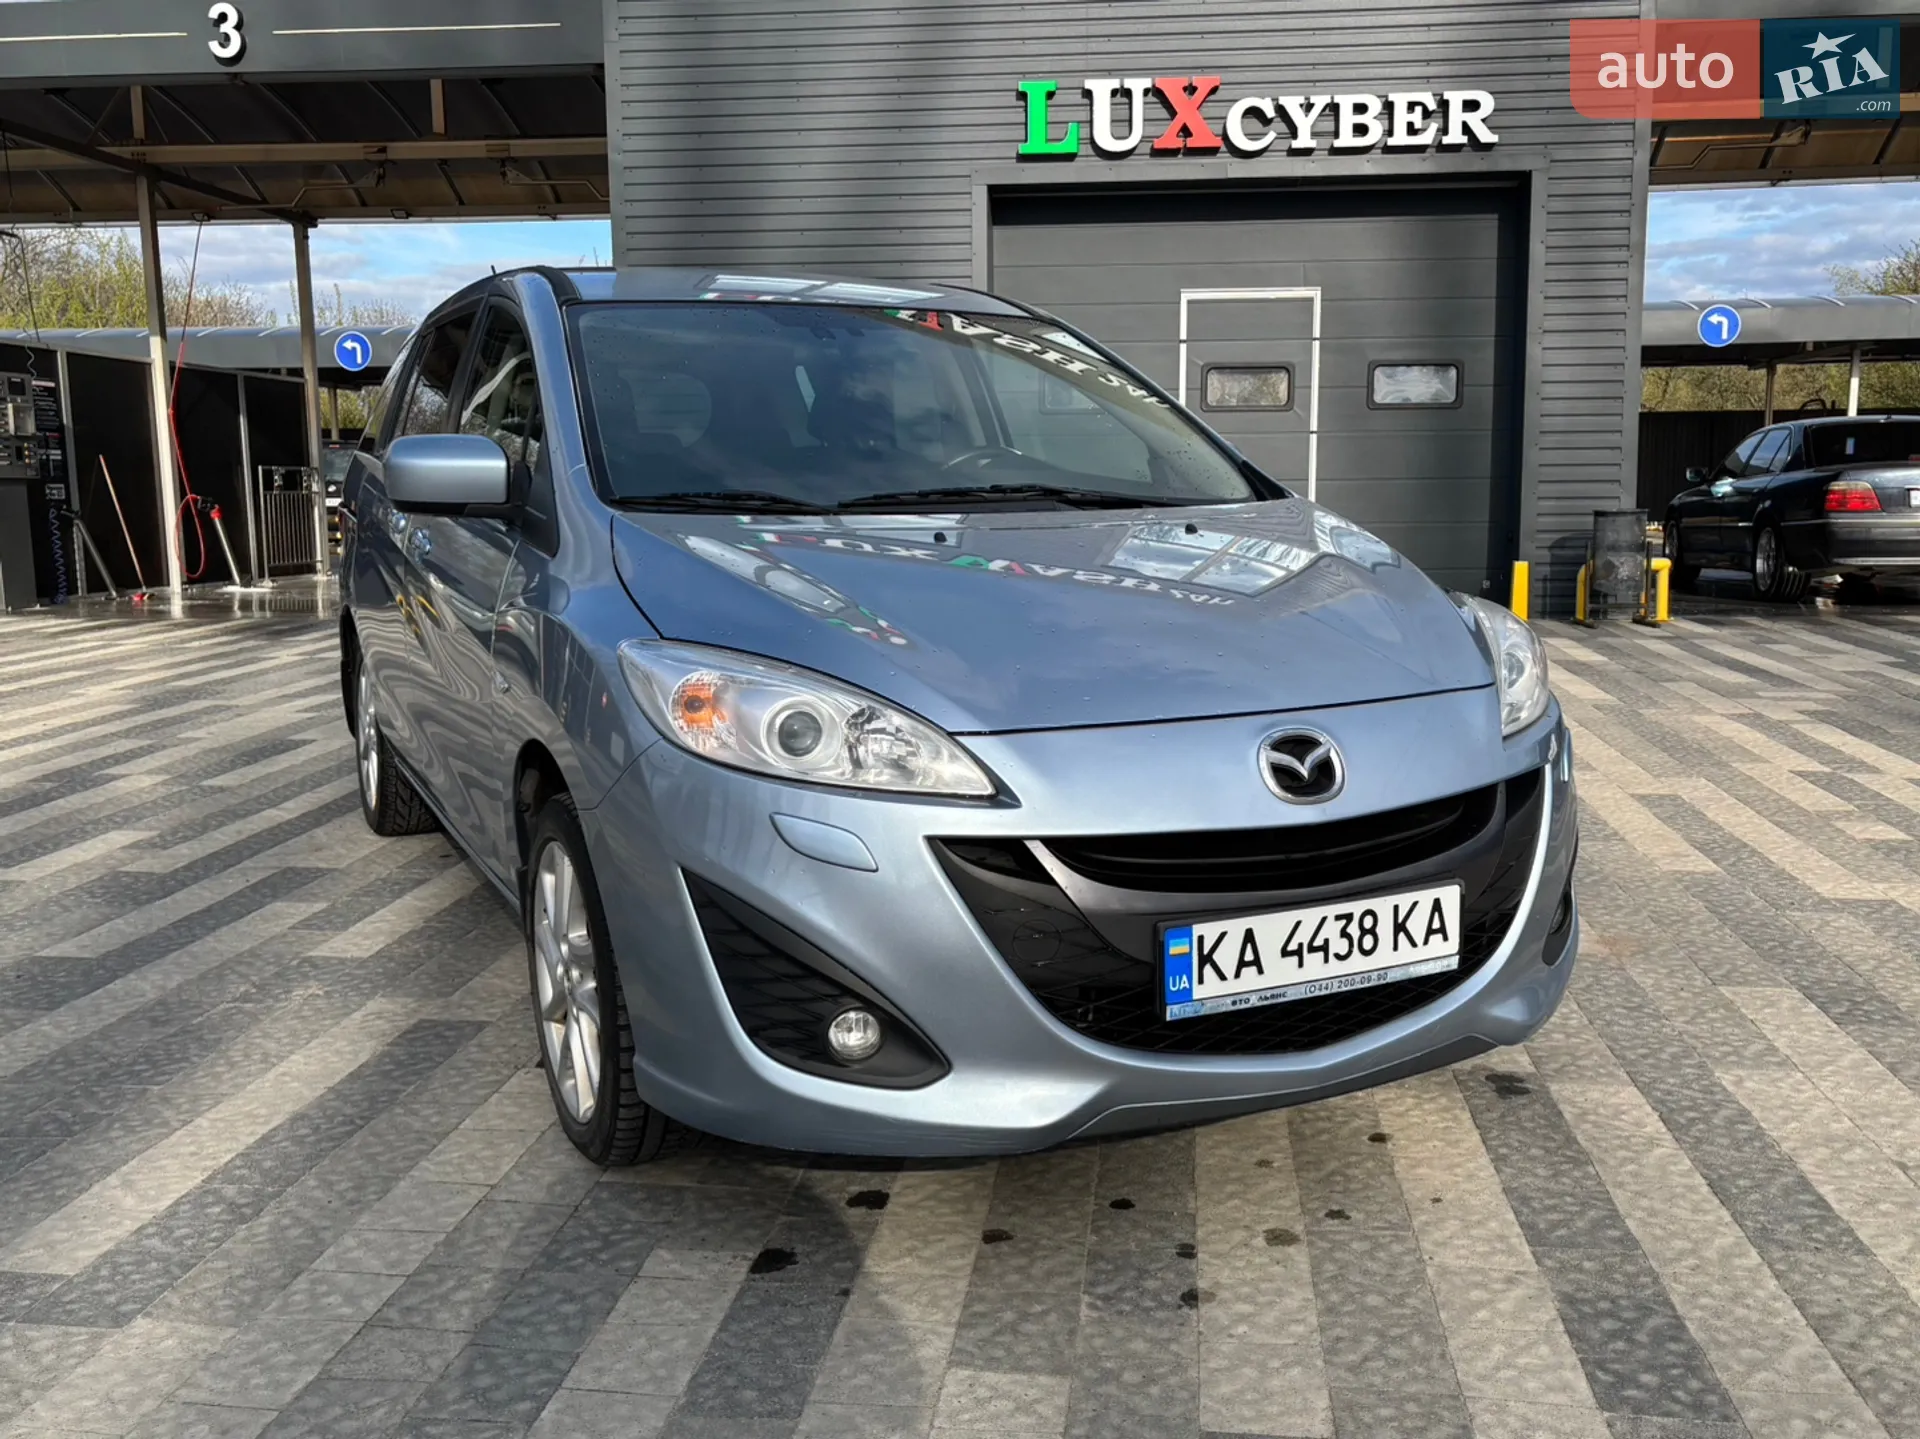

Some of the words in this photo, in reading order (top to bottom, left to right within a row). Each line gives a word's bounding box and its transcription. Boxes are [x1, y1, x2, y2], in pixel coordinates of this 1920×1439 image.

[207, 2, 241, 58] 3
[1197, 927, 1265, 985] KA
[1281, 909, 1379, 969] 4438
[1393, 897, 1449, 952] KA
[1169, 974, 1190, 992] UA
